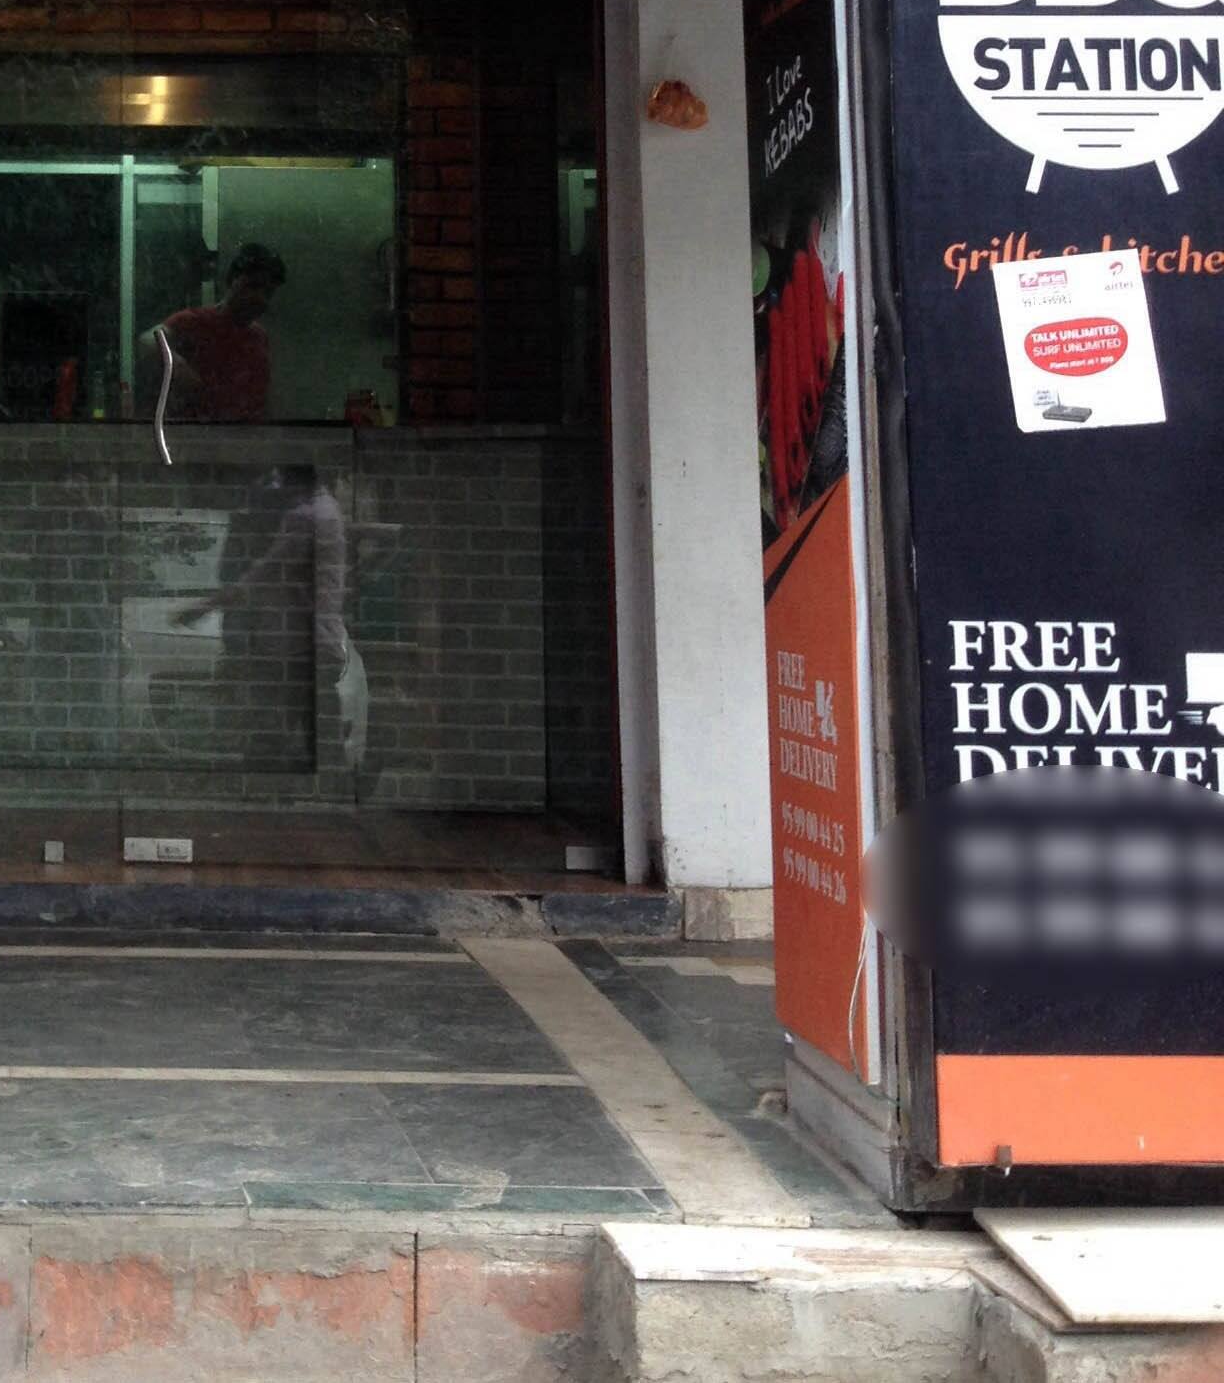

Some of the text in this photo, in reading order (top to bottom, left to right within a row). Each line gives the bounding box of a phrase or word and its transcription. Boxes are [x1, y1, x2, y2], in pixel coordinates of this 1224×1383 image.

[974, 36, 1222, 93] STATION
[766, 74, 775, 115] I
[764, 87, 814, 178] KEBABS
[1031, 325, 1119, 343] TALK UNLIMITED
[1032, 338, 1122, 357] SURF UNLIMITED
[949, 620, 1121, 672] FREE
[777, 650, 806, 691] FREE
[779, 693, 816, 738] HOME
[952, 683, 1173, 735] HOME
[780, 736, 839, 792] DELIVERY
